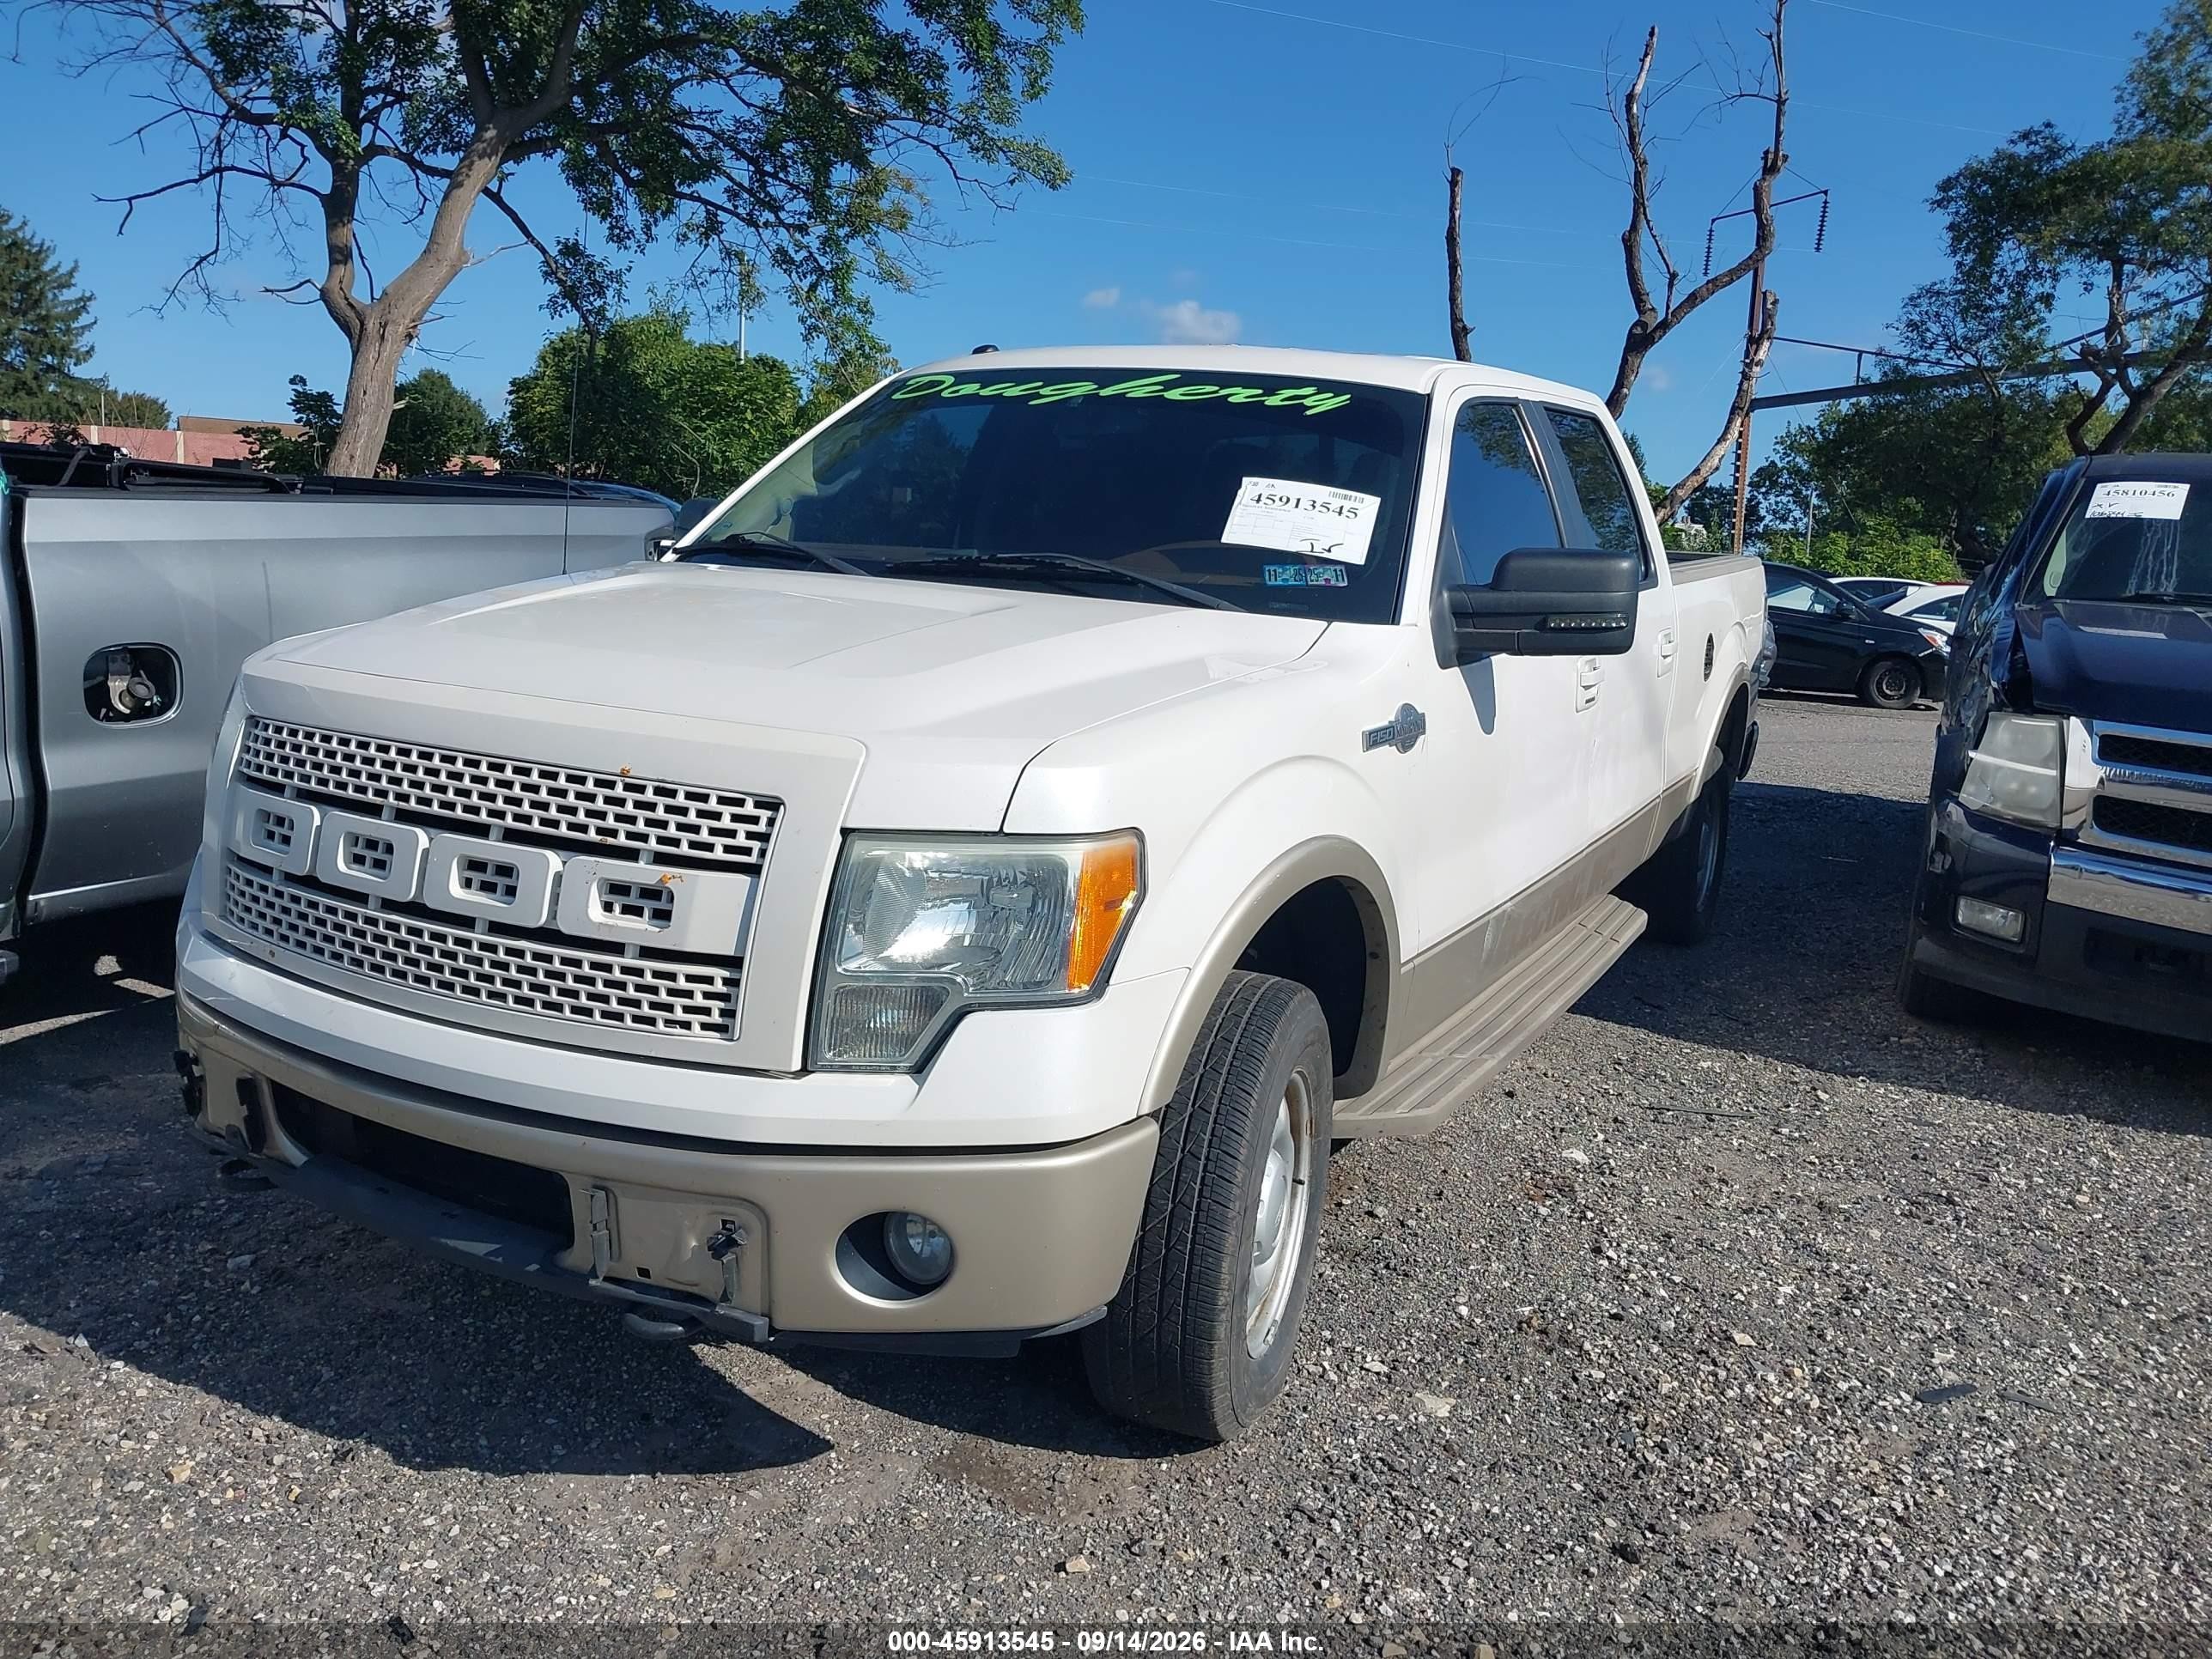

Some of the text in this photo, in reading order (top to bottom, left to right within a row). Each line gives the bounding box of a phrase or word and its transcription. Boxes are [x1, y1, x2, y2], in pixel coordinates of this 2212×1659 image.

[892, 374, 1351, 415] Dougherty
[1250, 493, 1359, 520] 45913545
[2103, 489, 2175, 498] 45810456
